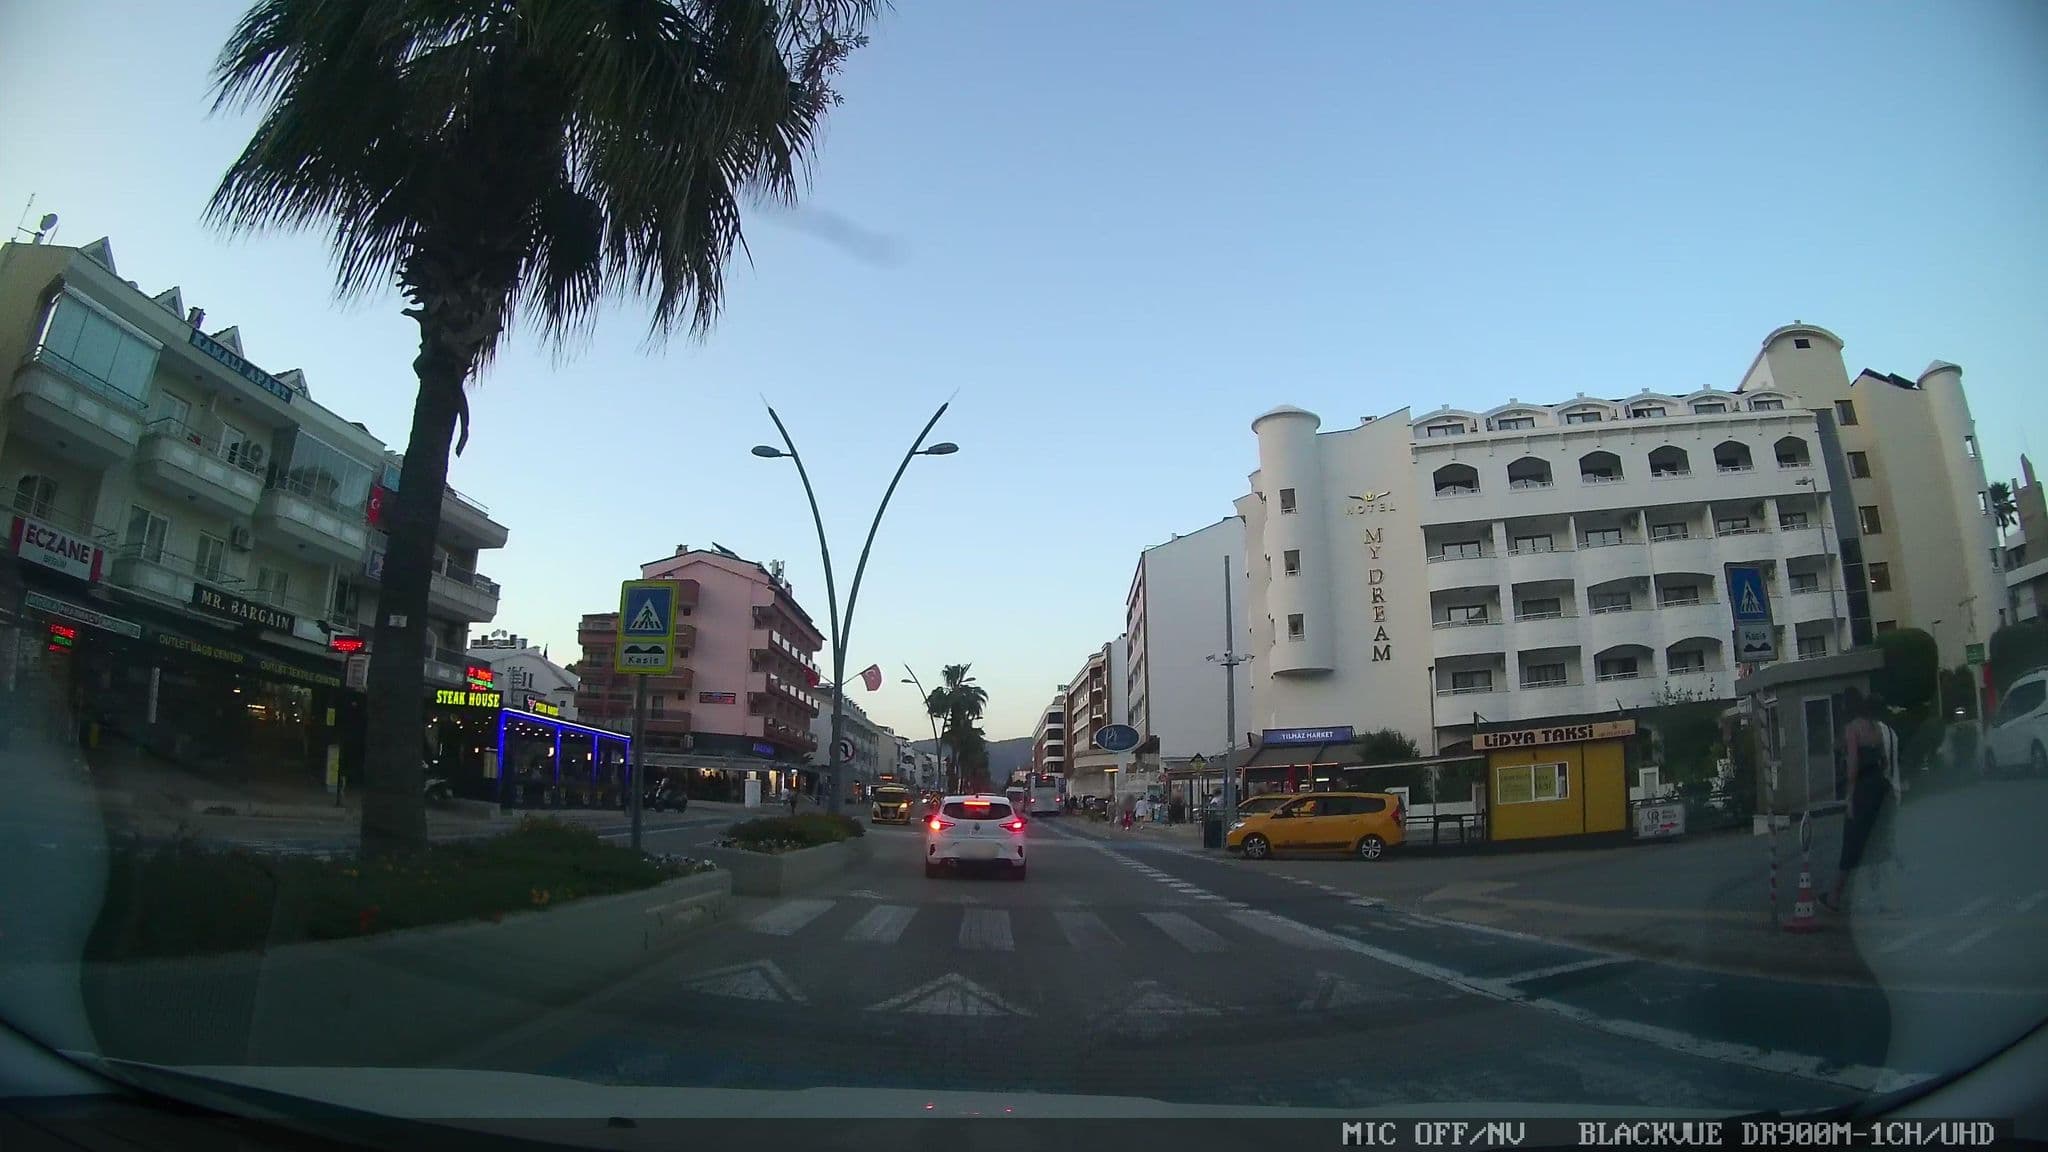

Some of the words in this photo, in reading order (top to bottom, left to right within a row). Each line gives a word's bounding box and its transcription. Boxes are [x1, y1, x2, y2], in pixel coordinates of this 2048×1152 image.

[1346, 502, 1396, 515] HOTEL
[26, 523, 91, 564] ECZANE
[1363, 527, 1384, 560] MY
[201, 590, 225, 611] MR.
[231, 600, 290, 630] BARGAIN
[1368, 569, 1393, 662] DREAM
[628, 656, 659, 665] Kasis
[436, 690, 466, 705] STEAK
[468, 692, 500, 707] HOUSE
[1306, 731, 1334, 739] MARKET
